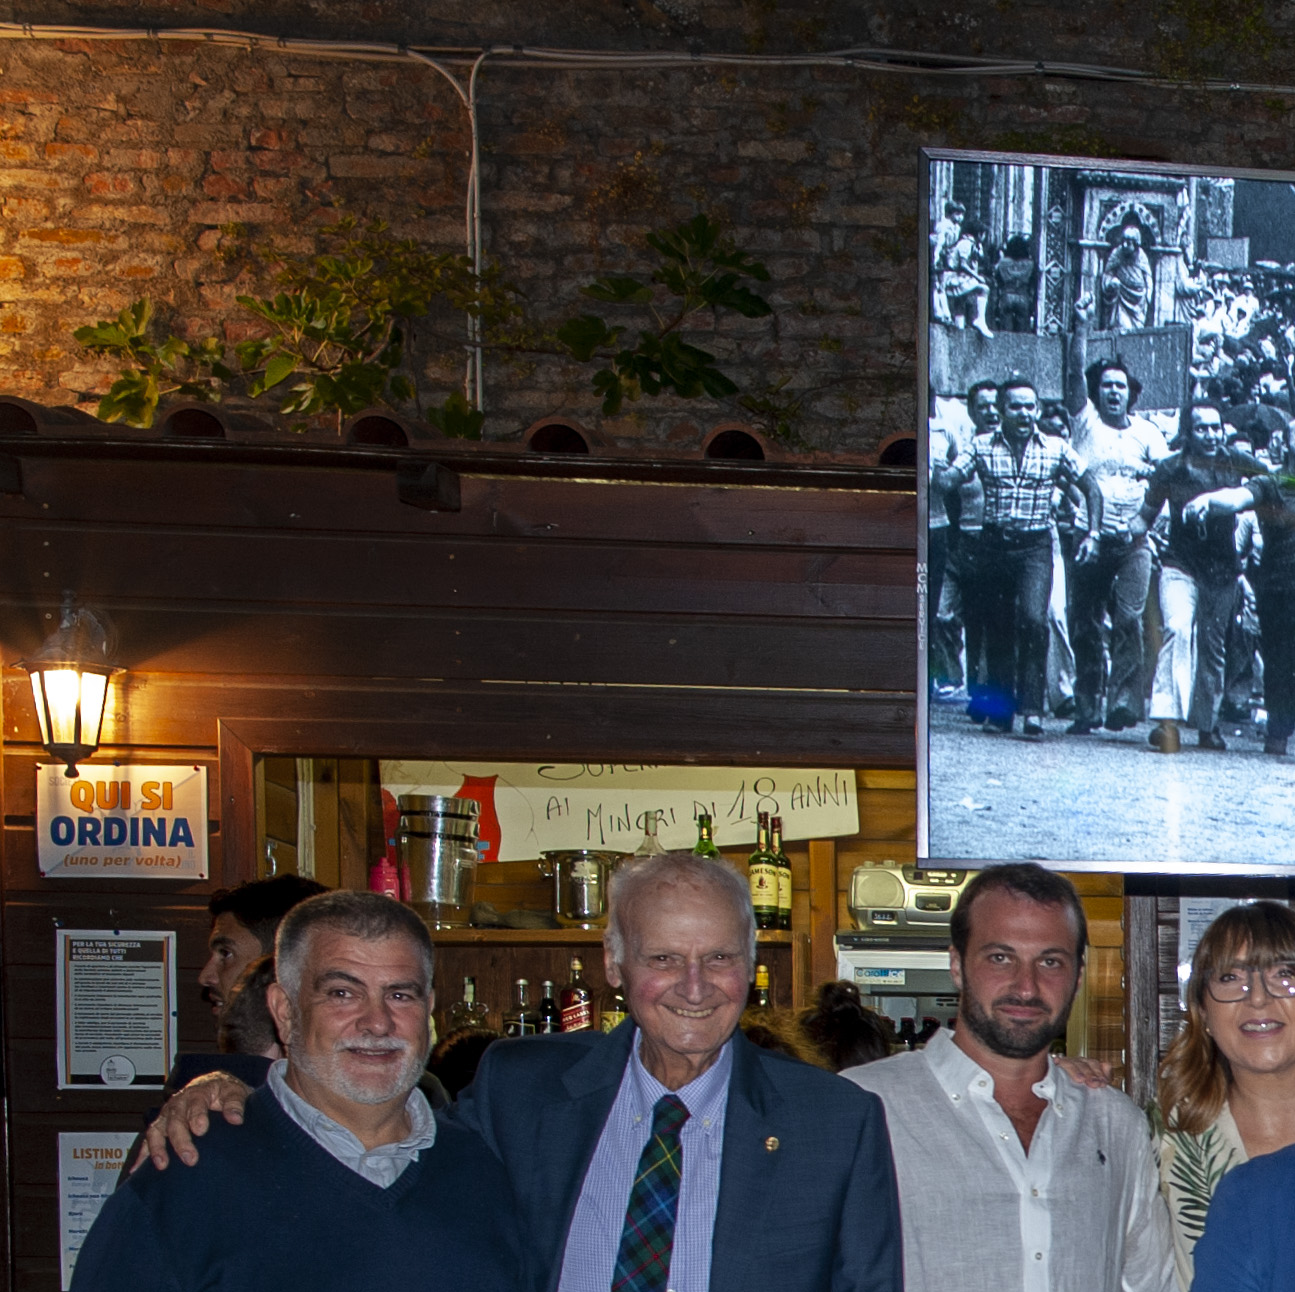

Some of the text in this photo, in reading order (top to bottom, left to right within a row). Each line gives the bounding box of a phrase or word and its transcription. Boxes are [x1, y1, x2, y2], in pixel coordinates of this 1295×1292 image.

[916, 562, 928, 594] MCM
[70, 780, 173, 814] QUI SI
[546, 796, 570, 820] AI
[727, 776, 780, 821] 18
[790, 772, 848, 811] ANNI
[50, 816, 195, 848] ORDINA
[64, 854, 98, 868] (uno
[102, 855, 130, 868] per
[135, 854, 182, 868] volta)
[72, 1148, 123, 1159] LISTINO
